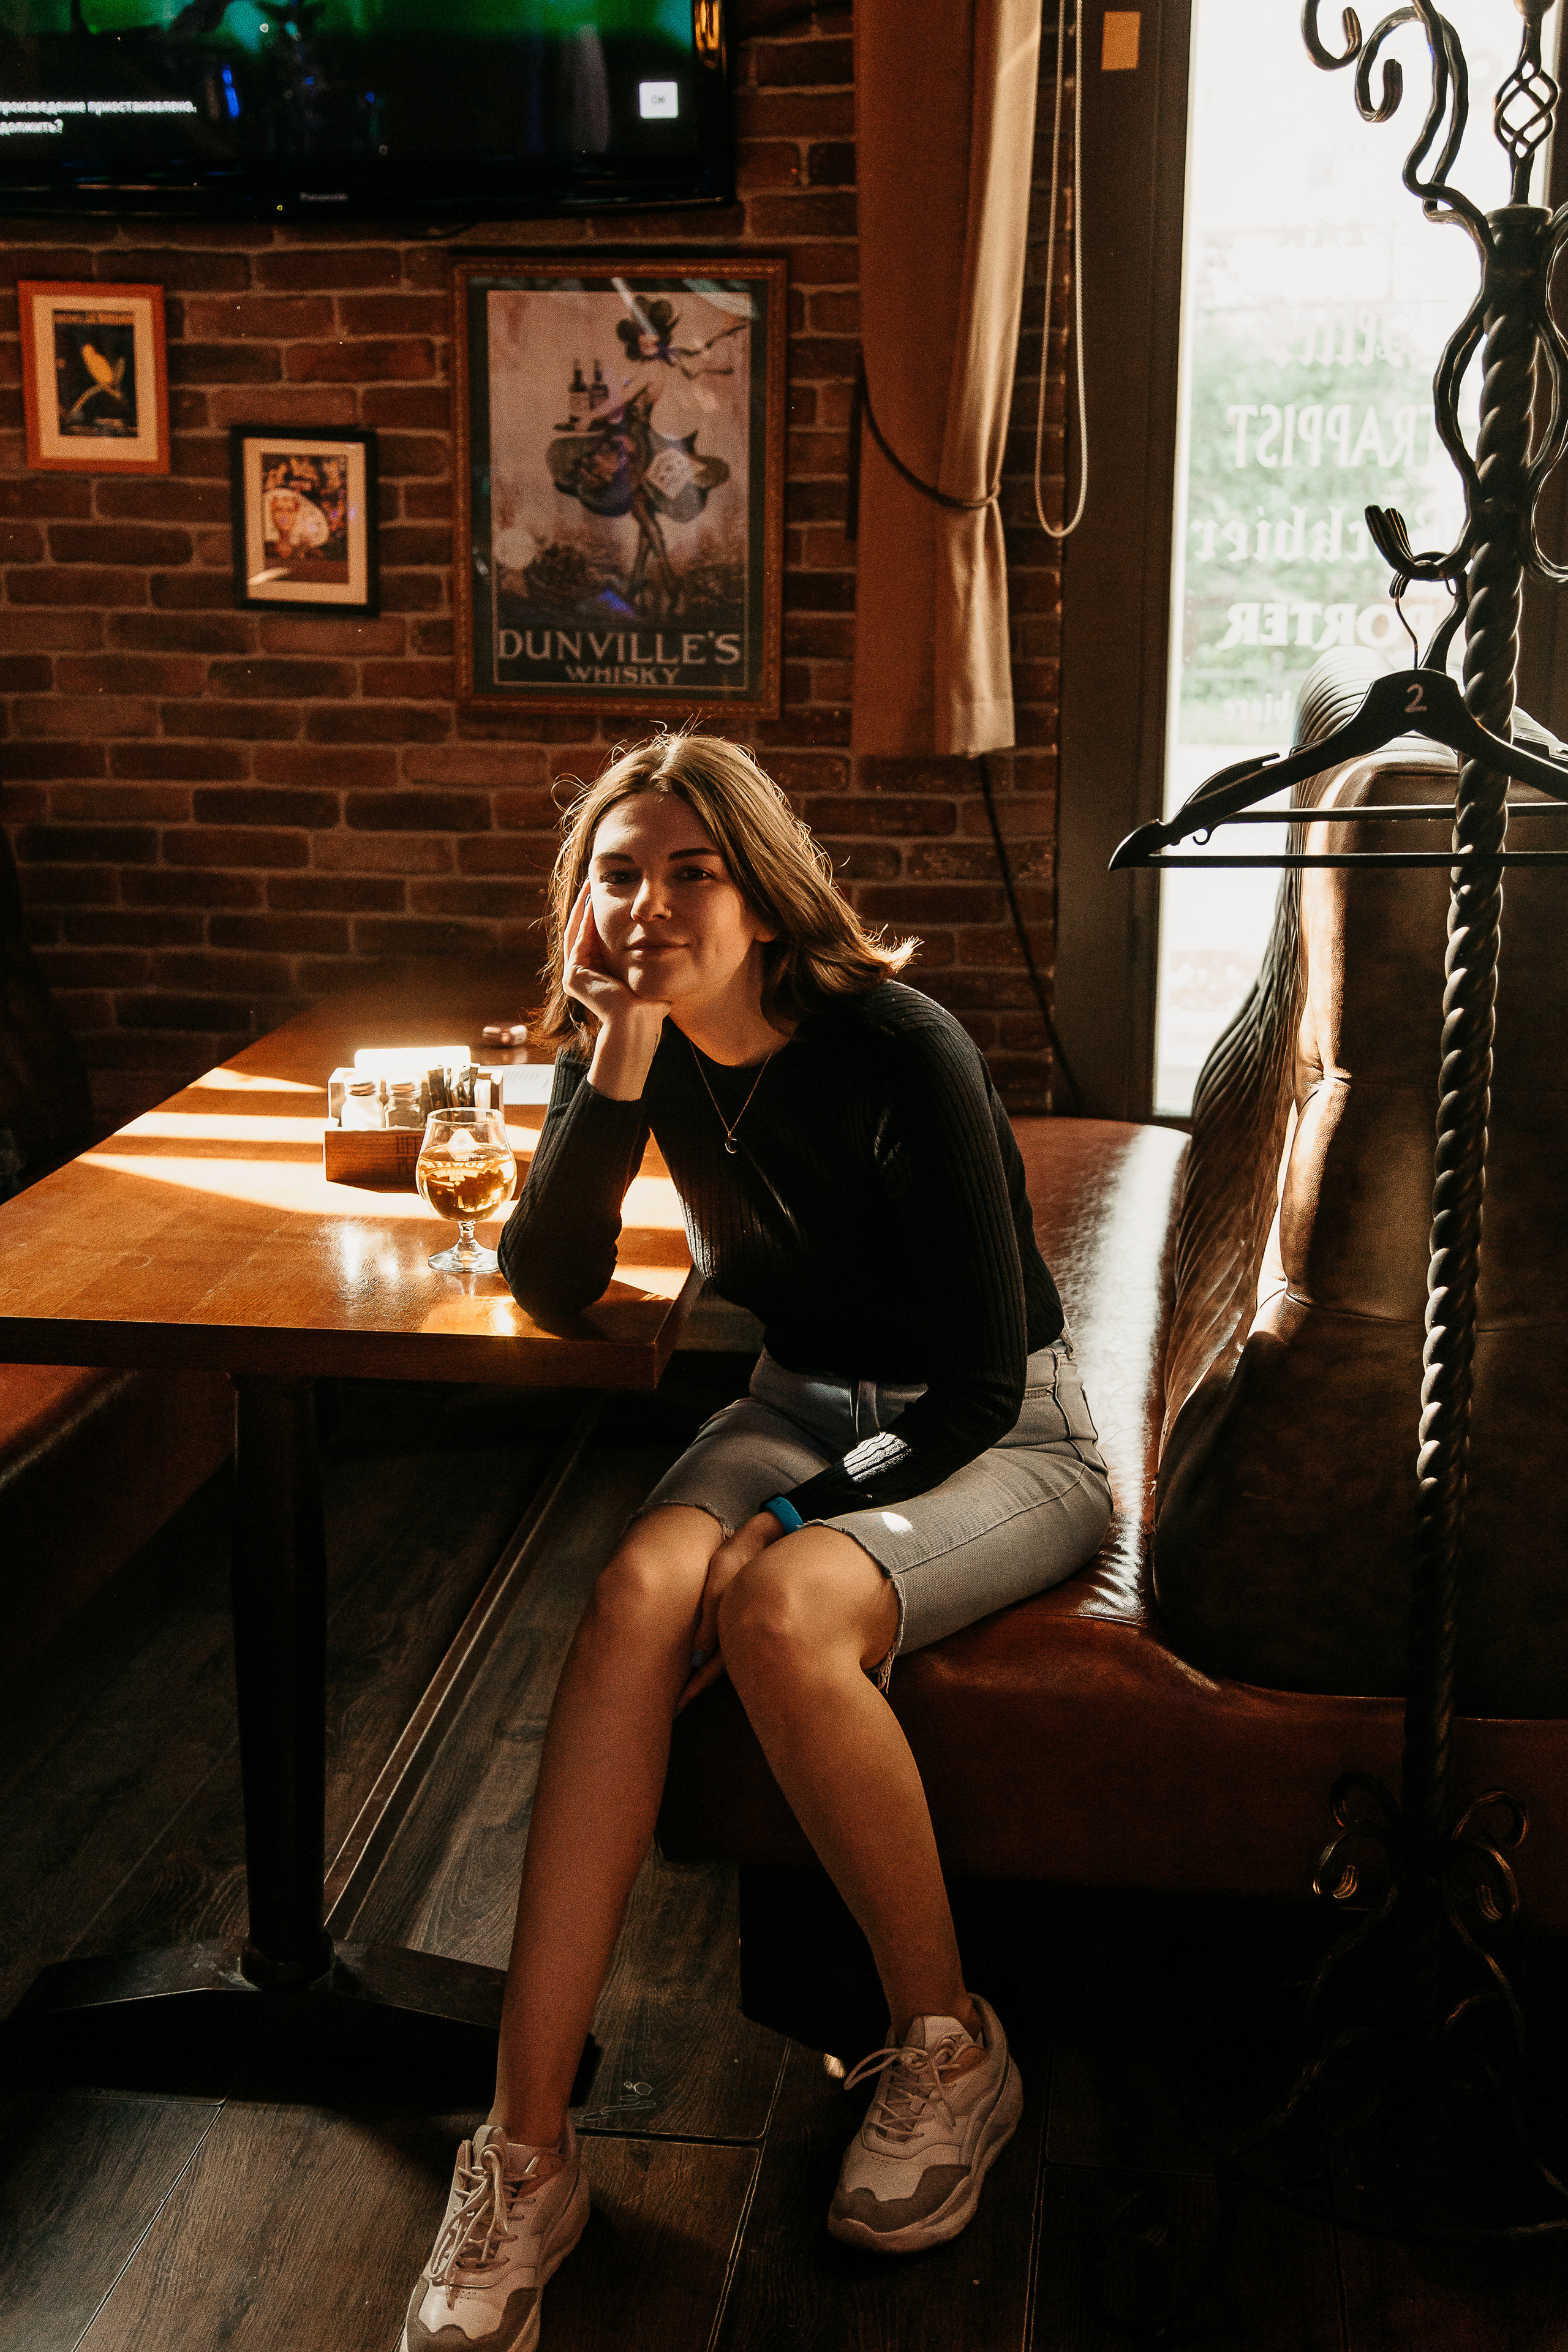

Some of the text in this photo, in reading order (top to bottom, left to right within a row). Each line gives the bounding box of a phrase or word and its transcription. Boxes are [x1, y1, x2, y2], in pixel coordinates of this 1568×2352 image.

[498, 628, 742, 665] DUNVILLE'S
[564, 665, 681, 685] WHISKY
[1404, 684, 1428, 713] 2
